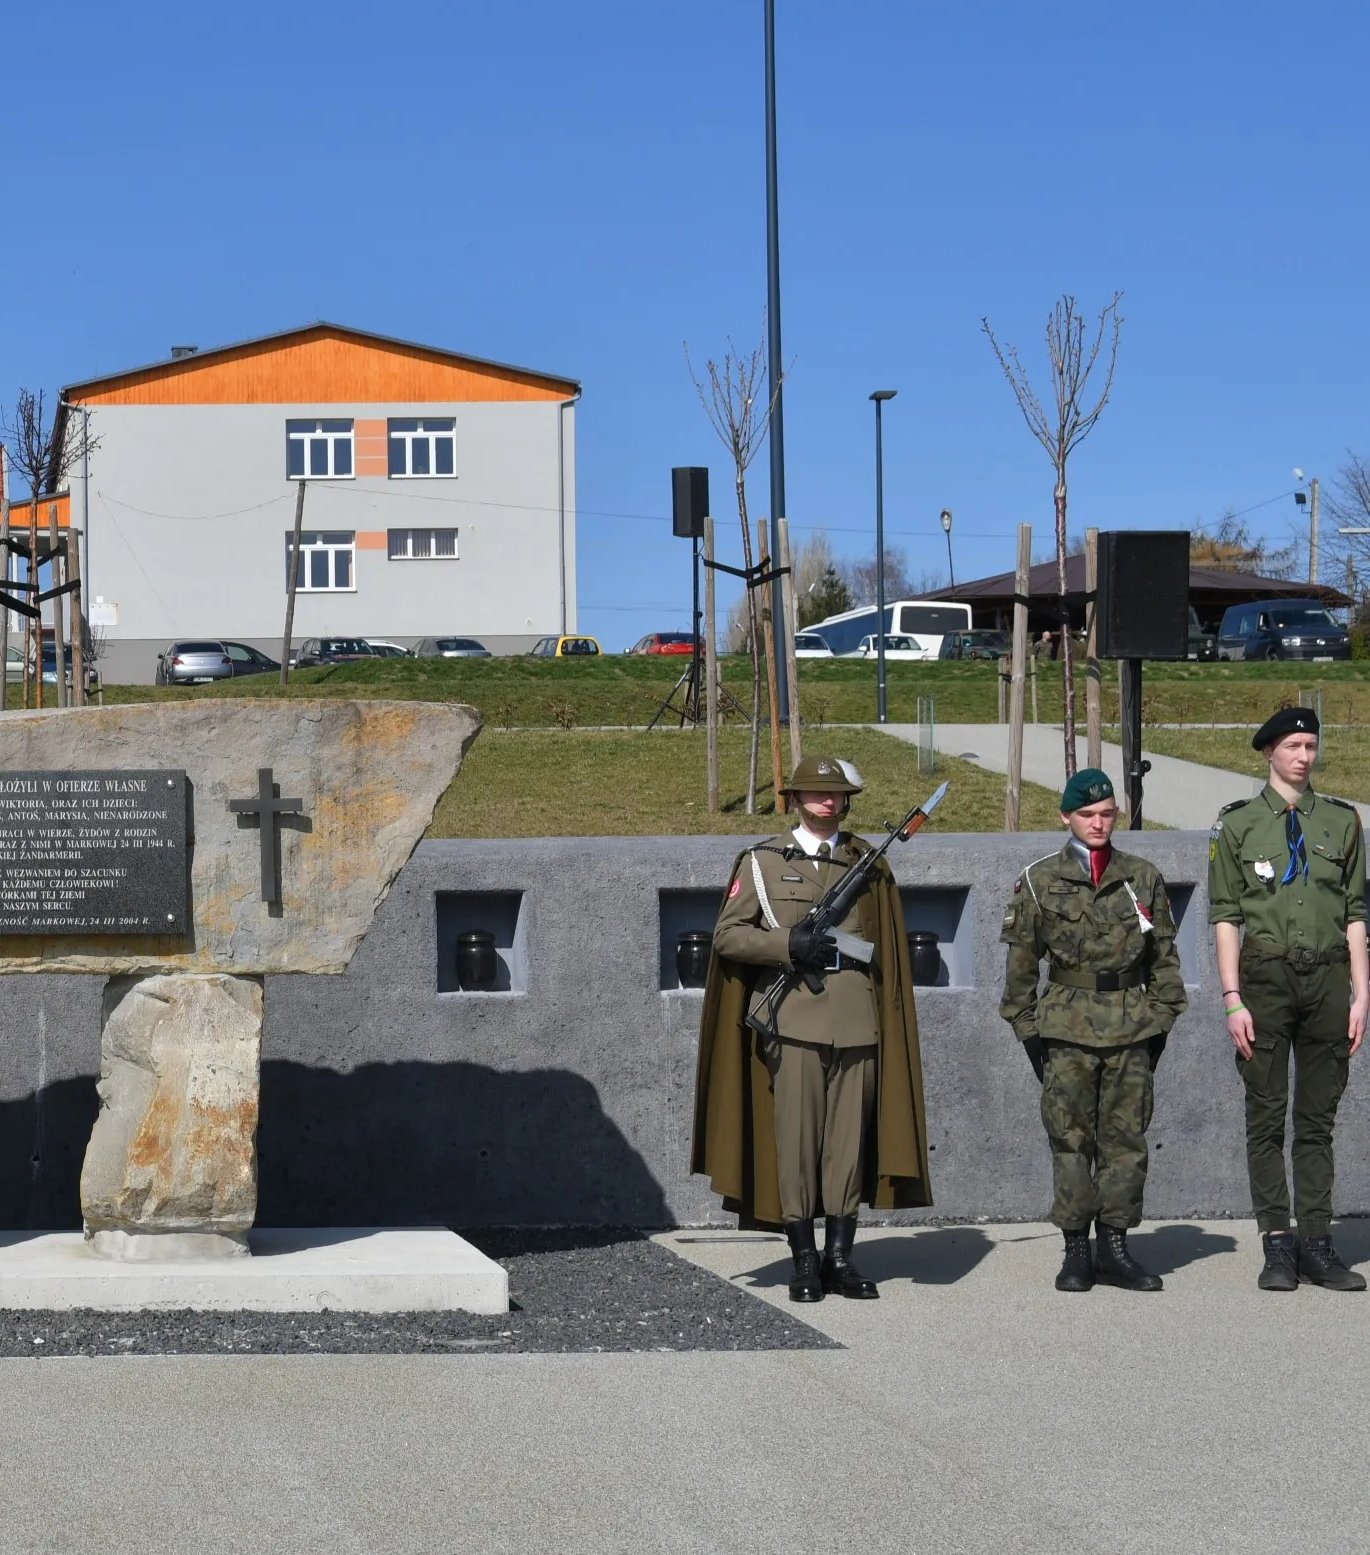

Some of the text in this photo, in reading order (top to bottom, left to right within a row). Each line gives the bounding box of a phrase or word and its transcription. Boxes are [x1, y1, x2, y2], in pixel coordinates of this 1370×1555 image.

[42, 780, 52, 793] W
[56, 780, 101, 792] OFIERZE
[105, 780, 147, 792] WŁASNE
[51, 799, 78, 808] ORAZ
[82, 799, 99, 808] ICH
[7, 809, 41, 822] ANTOŚ,
[44, 811, 90, 822] MARYSIA,
[93, 811, 168, 820] NIENARODZONE
[27, 829, 35, 838] W
[78, 826, 111, 837] ŻYDÓW
[115, 829, 121, 837] Z
[124, 829, 157, 837] RODZIN
[21, 840, 27, 849] Z
[30, 840, 51, 848] NIMI
[54, 840, 63, 848] W
[66, 840, 117, 849] MARKOWEJ
[120, 840, 129, 848] 24
[133, 840, 143, 848] III
[146, 840, 164, 848] 1944
[167, 840, 176, 848] R.
[6, 869, 61, 877] WEZWANIEM
[64, 869, 77, 877] DO
[80, 869, 127, 877] SZACUNKU
[2, 878, 46, 888] KAŻDEMU
[41, 891, 56, 900] TEJ
[59, 891, 85, 899] ZIEMI
[3, 902, 39, 910] NASZYM
[42, 902, 73, 910] SERCU.
